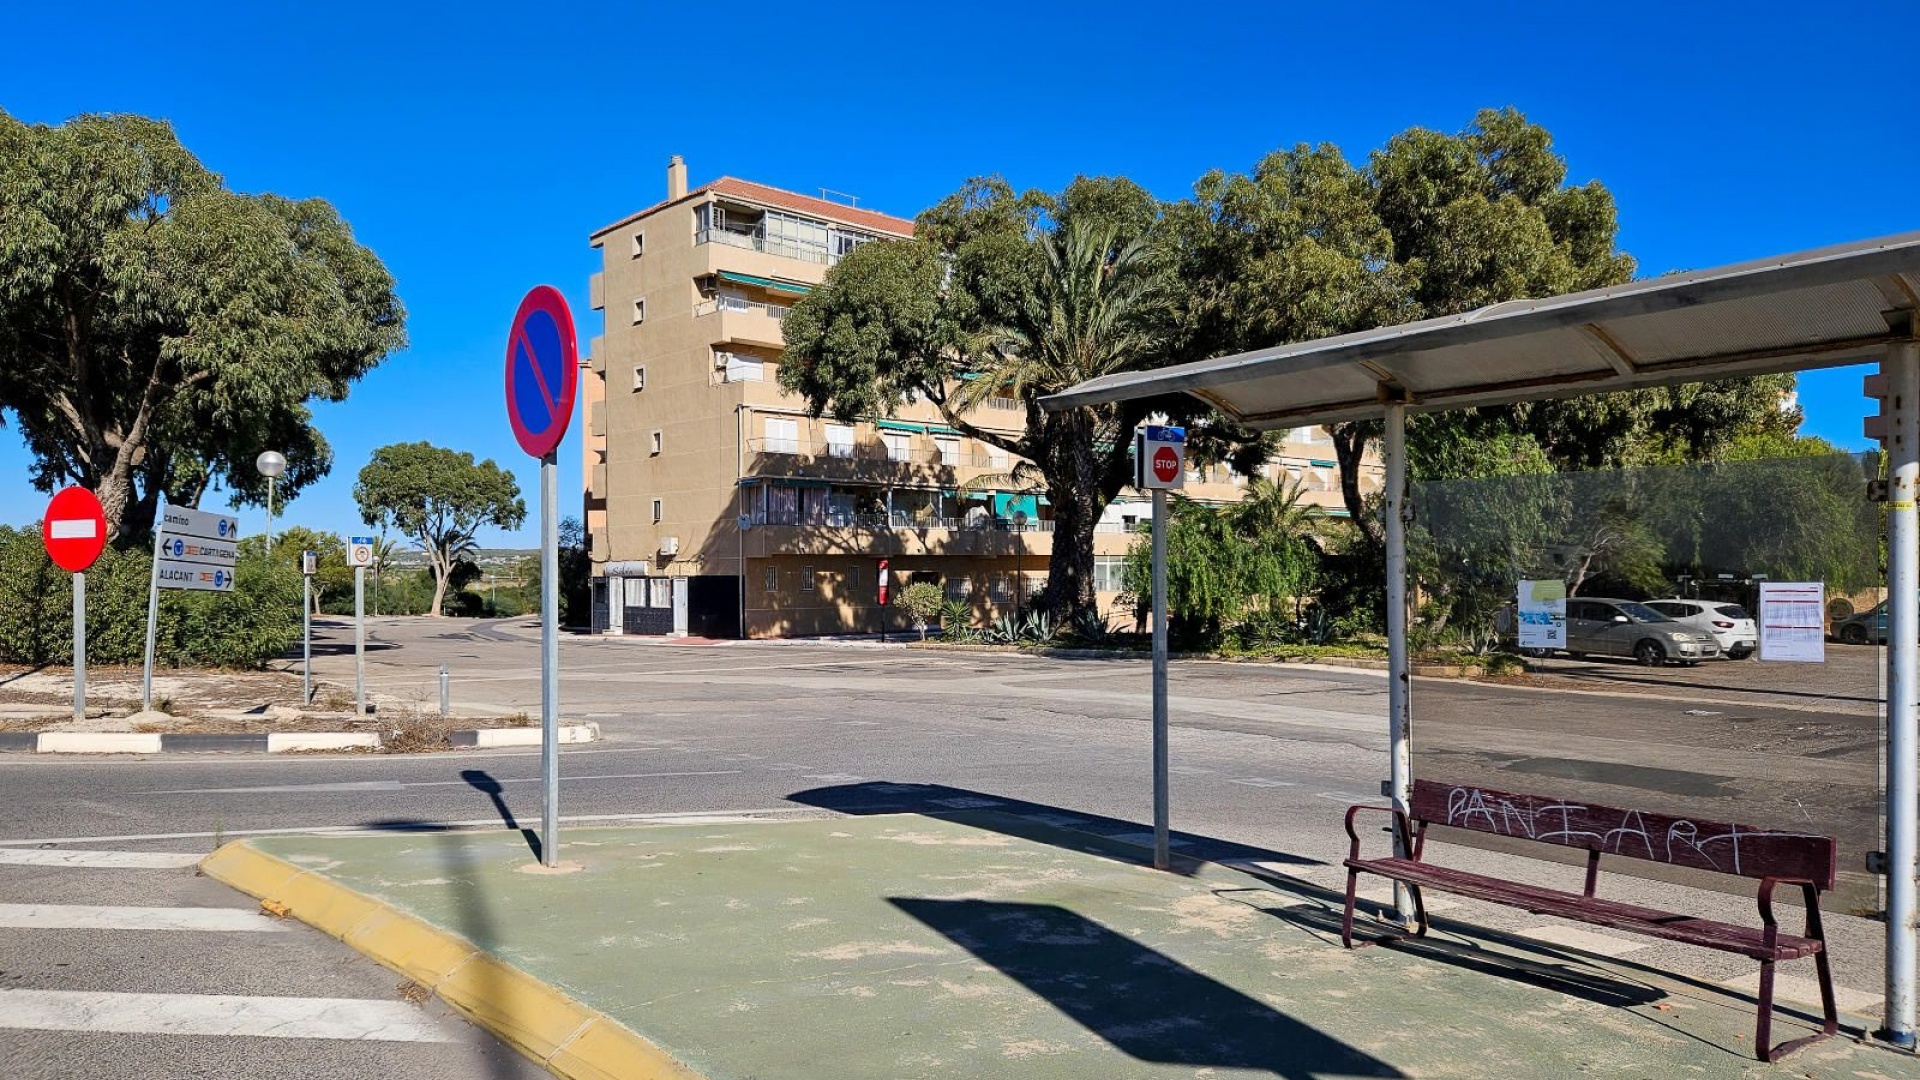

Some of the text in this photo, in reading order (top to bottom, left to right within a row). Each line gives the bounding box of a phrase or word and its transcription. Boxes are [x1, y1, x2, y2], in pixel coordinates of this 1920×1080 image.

[1155, 459, 1177, 470] STOP
[164, 514, 189, 526] camino
[199, 546, 235, 559] CARTAGENA
[159, 569, 194, 582] ALACANT
